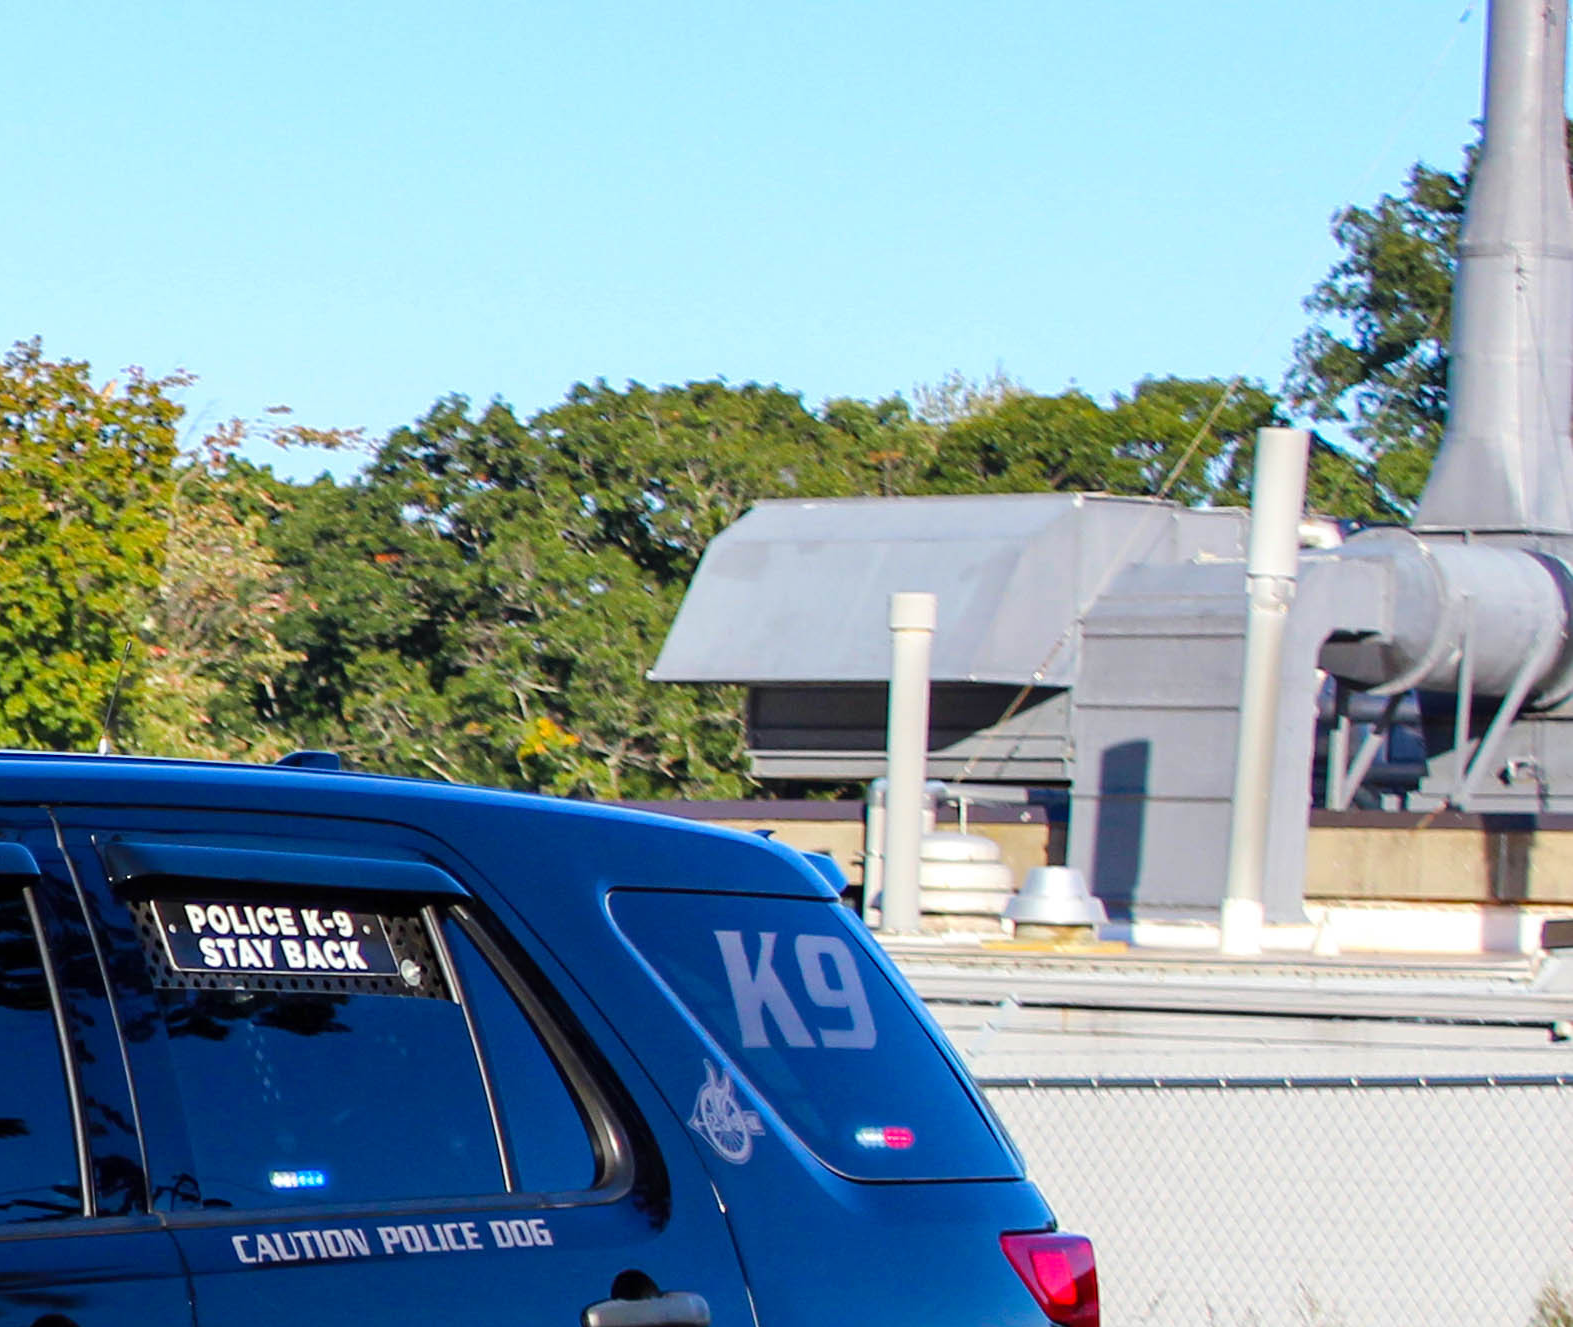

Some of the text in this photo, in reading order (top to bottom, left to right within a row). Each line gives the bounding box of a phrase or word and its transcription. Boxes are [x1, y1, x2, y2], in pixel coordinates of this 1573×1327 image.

[184, 904, 354, 938] POLICE K-9
[198, 937, 368, 970] STAY BACK
[713, 930, 877, 1049] K9
[231, 1218, 554, 1264] CAUTION POLICE DOG
